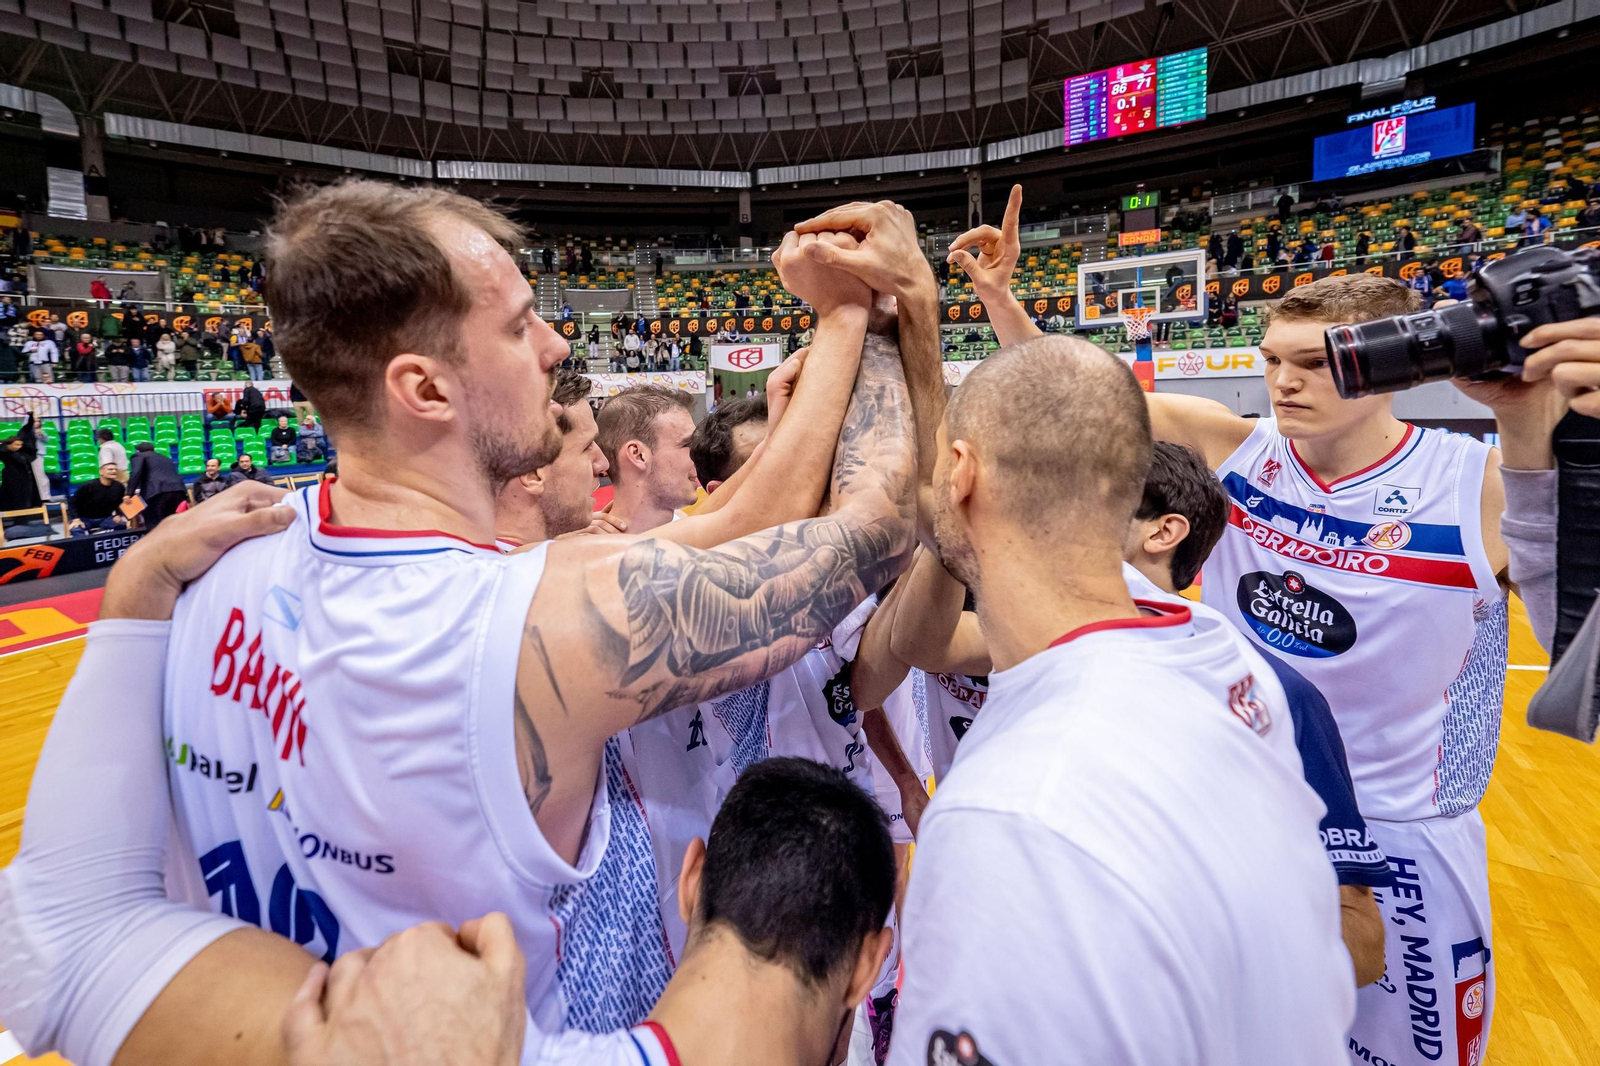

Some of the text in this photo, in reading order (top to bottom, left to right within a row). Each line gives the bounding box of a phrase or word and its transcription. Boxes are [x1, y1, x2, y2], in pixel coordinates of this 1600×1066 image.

[1111, 77, 1152, 95] 86 71
[1117, 96, 1136, 110] 0.1
[1347, 107, 1390, 124] FINAL
[94, 533, 146, 551] FEDER
[1242, 516, 1390, 574] OBRADOIRO
[23, 548, 55, 561] FEB
[95, 549, 115, 563] DE
[1253, 579, 1334, 626] Estrella
[1250, 597, 1323, 643] Galicia
[1400, 934, 1443, 1061] MADRID
